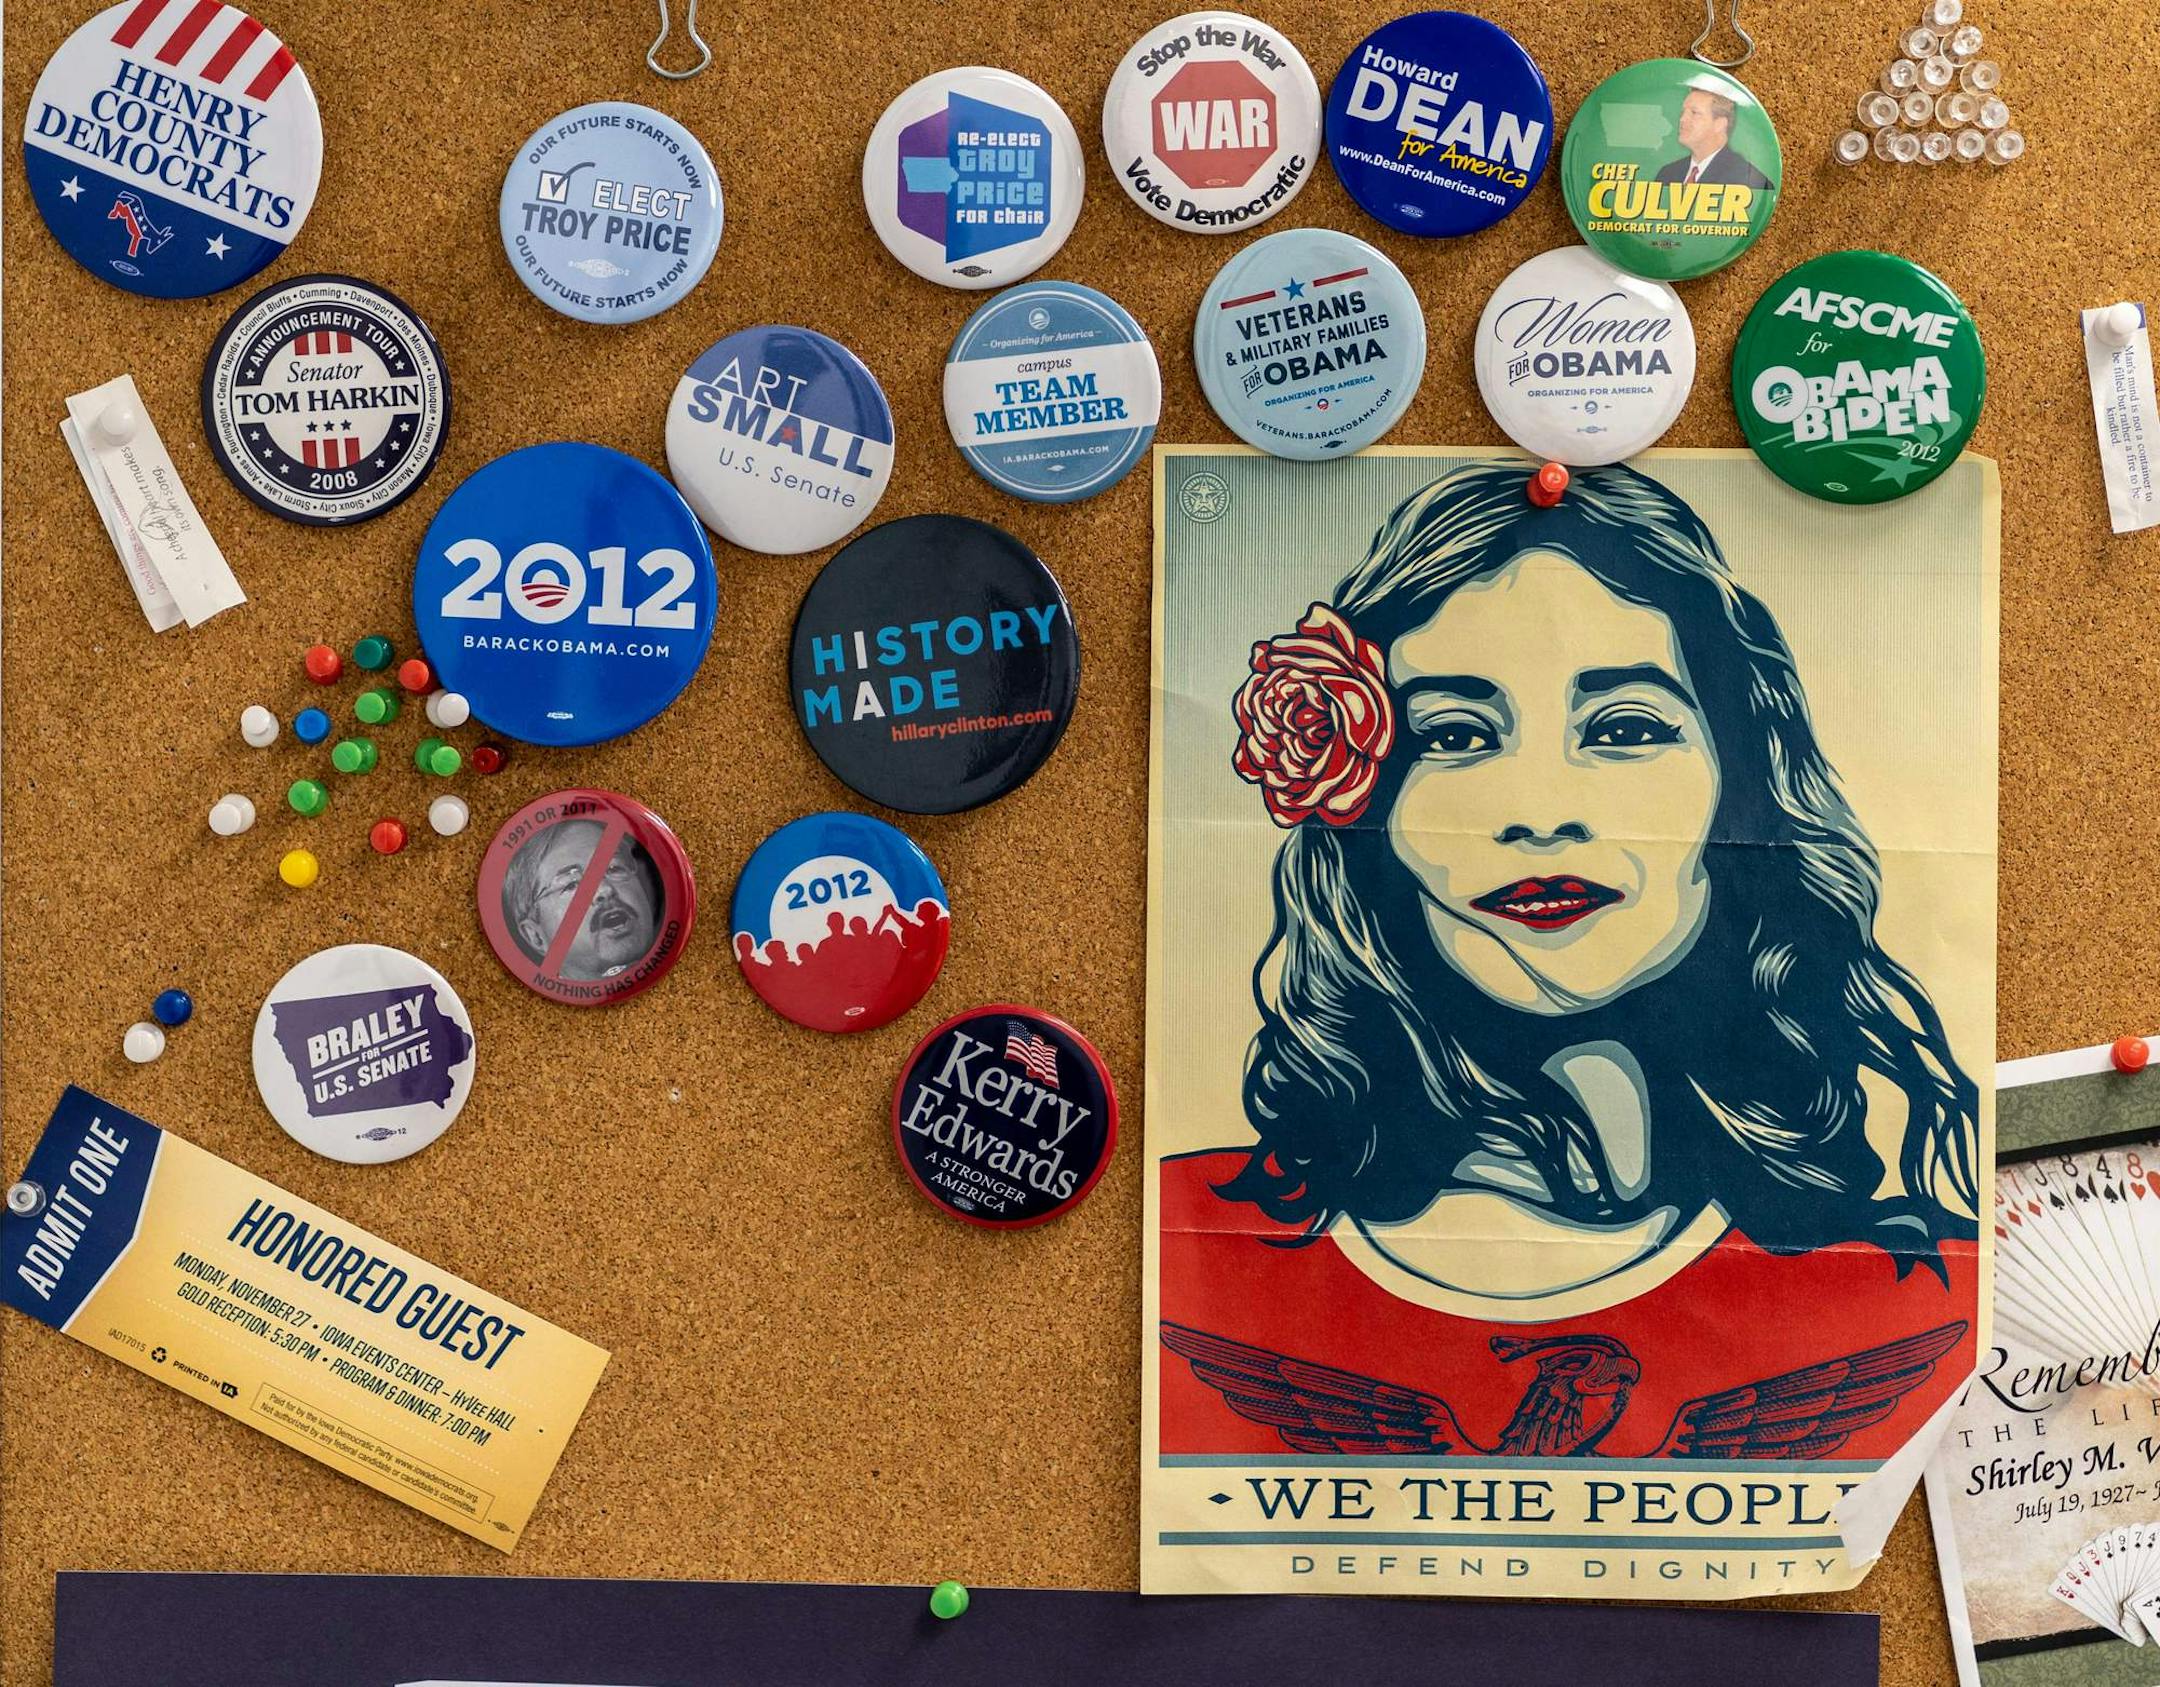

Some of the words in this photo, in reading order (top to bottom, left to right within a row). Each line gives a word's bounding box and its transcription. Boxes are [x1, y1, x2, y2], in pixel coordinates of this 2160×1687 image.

[1137, 35, 1191, 77] Stop
[1195, 25, 1236, 47] the
[1241, 30, 1286, 71] War
[1362, 45, 1459, 92] Howard
[112, 59, 267, 141] HENRY
[1346, 66, 1544, 172] DEAN
[90, 90, 266, 178] COUNTY
[1160, 99, 1269, 151] WAR
[35, 103, 294, 229] DEMOCRATS
[530, 135, 558, 165] OUR
[557, 116, 620, 140] FUTURE
[625, 118, 680, 154] STARTS
[678, 154, 702, 190] NOW
[1399, 129, 1435, 160] for
[1440, 144, 1528, 189] America
[1592, 163, 1640, 180] CHET
[1126, 156, 1172, 211] Vote
[1175, 155, 1305, 226] Democratic
[1339, 145, 1506, 206] www.DeanForAmerica.com
[593, 179, 692, 220] ELECT
[1588, 180, 1754, 224] CULVER
[522, 203, 598, 240] TROY
[604, 216, 691, 255] PRICE
[1588, 221, 1653, 234] DEMOCRAT
[1656, 223, 1680, 234] FOR
[1683, 224, 1749, 237] GOVERNOR
[516, 236, 537, 269] OUR
[535, 267, 591, 307] FUTURE
[596, 287, 656, 308] STARTS
[657, 259, 688, 291] NOW
[266, 296, 292, 312] Bluffs
[299, 289, 341, 299] Cumming
[350, 291, 393, 318] Davenport
[240, 308, 267, 336] Council
[397, 319, 412, 336] Des
[1236, 291, 1366, 341] VETERANS
[1495, 293, 1672, 349] Women
[1774, 286, 1959, 349] AFSCME
[221, 341, 240, 371] Rapids
[250, 312, 362, 368] ANNOUNCEMENT
[366, 323, 399, 360] TOUR
[410, 334, 429, 366] Moines
[990, 335, 1040, 349] Organizing
[1039, 333, 1054, 344] for
[1055, 330, 1094, 342] America
[1226, 352, 1236, 367] &
[1241, 333, 1311, 363] MILITARY
[1319, 314, 1389, 344] FAMILIES
[1797, 332, 1833, 356] for
[287, 361, 363, 383] Senator
[711, 357, 808, 413] ART
[1017, 358, 1072, 373] campus
[1243, 371, 1262, 393] FOR
[1264, 339, 1388, 386] OBAMA
[1508, 359, 1530, 380] FOR
[1533, 350, 1672, 379] OBAMA
[217, 373, 228, 399] Cedar
[235, 392, 300, 416] TOM
[308, 384, 419, 412] HARKIN
[427, 374, 437, 414] Dubuque
[996, 373, 1098, 405] TEAM
[1264, 389, 1317, 407] ORGANIZING
[1319, 383, 1336, 395] FOR
[1337, 375, 1376, 390] AMERICA
[1527, 388, 1587, 397] ORGANIZING
[1589, 388, 1609, 396] FOR
[1611, 386, 1653, 395] AMERICA
[1751, 355, 1952, 424] OBAMA
[219, 408, 239, 455] Burlington
[423, 423, 436, 444] Iowa
[687, 384, 873, 478] SMALL
[974, 398, 1128, 435] MEMBER
[1256, 388, 1392, 440] VETERANS.BARACKOBAMA.COM
[1792, 389, 1951, 442] BIDEN
[121, 446, 145, 483] makes
[240, 459, 261, 481] Ames
[412, 445, 428, 463] City
[1003, 445, 1110, 464] IA.BARACKOBAMA.COM
[1898, 441, 1941, 462] 2012
[263, 483, 283, 499] Lake
[310, 471, 358, 490] 2008
[372, 488, 389, 501] City
[389, 467, 414, 491] Mason
[719, 448, 760, 477] U.S.
[770, 466, 856, 508] Senate
[284, 494, 311, 511] Storm
[319, 502, 337, 512] City
[340, 499, 365, 510] Sioux
[441, 538, 696, 630] 2012
[463, 635, 670, 658] BARACKOBAMA.COM
[812, 604, 1058, 676] HISTORY
[803, 669, 960, 728] MADE
[891, 708, 1053, 742] hillaryclinton.com
[502, 819, 532, 849] 1991
[535, 807, 556, 824] OR
[786, 870, 872, 910] 2012
[533, 972, 601, 999] NOTHING
[604, 977, 634, 996] HAS
[634, 920, 680, 981] CHANGED
[307, 993, 425, 1069] BRALEY
[313, 1074, 354, 1104] U.S.
[358, 1040, 433, 1088] SENATE
[361, 1047, 381, 1062] FOR
[932, 1030, 1091, 1150] Kerry
[901, 1084, 1078, 1200] Edwards
[925, 1152, 937, 1163] A
[940, 1157, 1027, 1205] STRONGER
[931, 1172, 1006, 1213] AMERICA
[17, 1184, 94, 1301] ADMIT
[68, 1116, 130, 1196] ONE
[226, 1198, 408, 1314] HONORED
[395, 1284, 526, 1371] GUEST
[173, 1252, 230, 1291] MONDAY,
[227, 1278, 295, 1322] NOVEMBER
[291, 1310, 312, 1328] 27
[319, 1324, 354, 1354] IOWA
[351, 1341, 399, 1373] EVENTS
[394, 1362, 444, 1397] CENTER
[485, 1406, 517, 1432] HALL
[173, 1360, 209, 1382] PRINTED
[211, 1379, 221, 1388] IN
[177, 1282, 210, 1306] GOLD
[205, 1296, 272, 1339] RECEPTION:
[270, 1327, 300, 1351] 5:30
[297, 1341, 321, 1362] PM
[329, 1358, 388, 1397] PROGRAM
[384, 1386, 397, 1400] &
[394, 1390, 443, 1424] DINNER:
[440, 1412, 469, 1436] 7:00
[467, 1425, 492, 1447] PM
[1959, 1418, 2046, 1448] THE
[1966, 1450, 2073, 1496] Shirley
[2082, 1441, 2126, 1476] M.
[1245, 1478, 1374, 1520] WE
[1399, 1478, 1555, 1522] THE
[2014, 1496, 2052, 1525] July
[2058, 1492, 2084, 1513] 19,
[1292, 1555, 1530, 1578] DEFEND
[1583, 1557, 1836, 1581] DIGNITY
